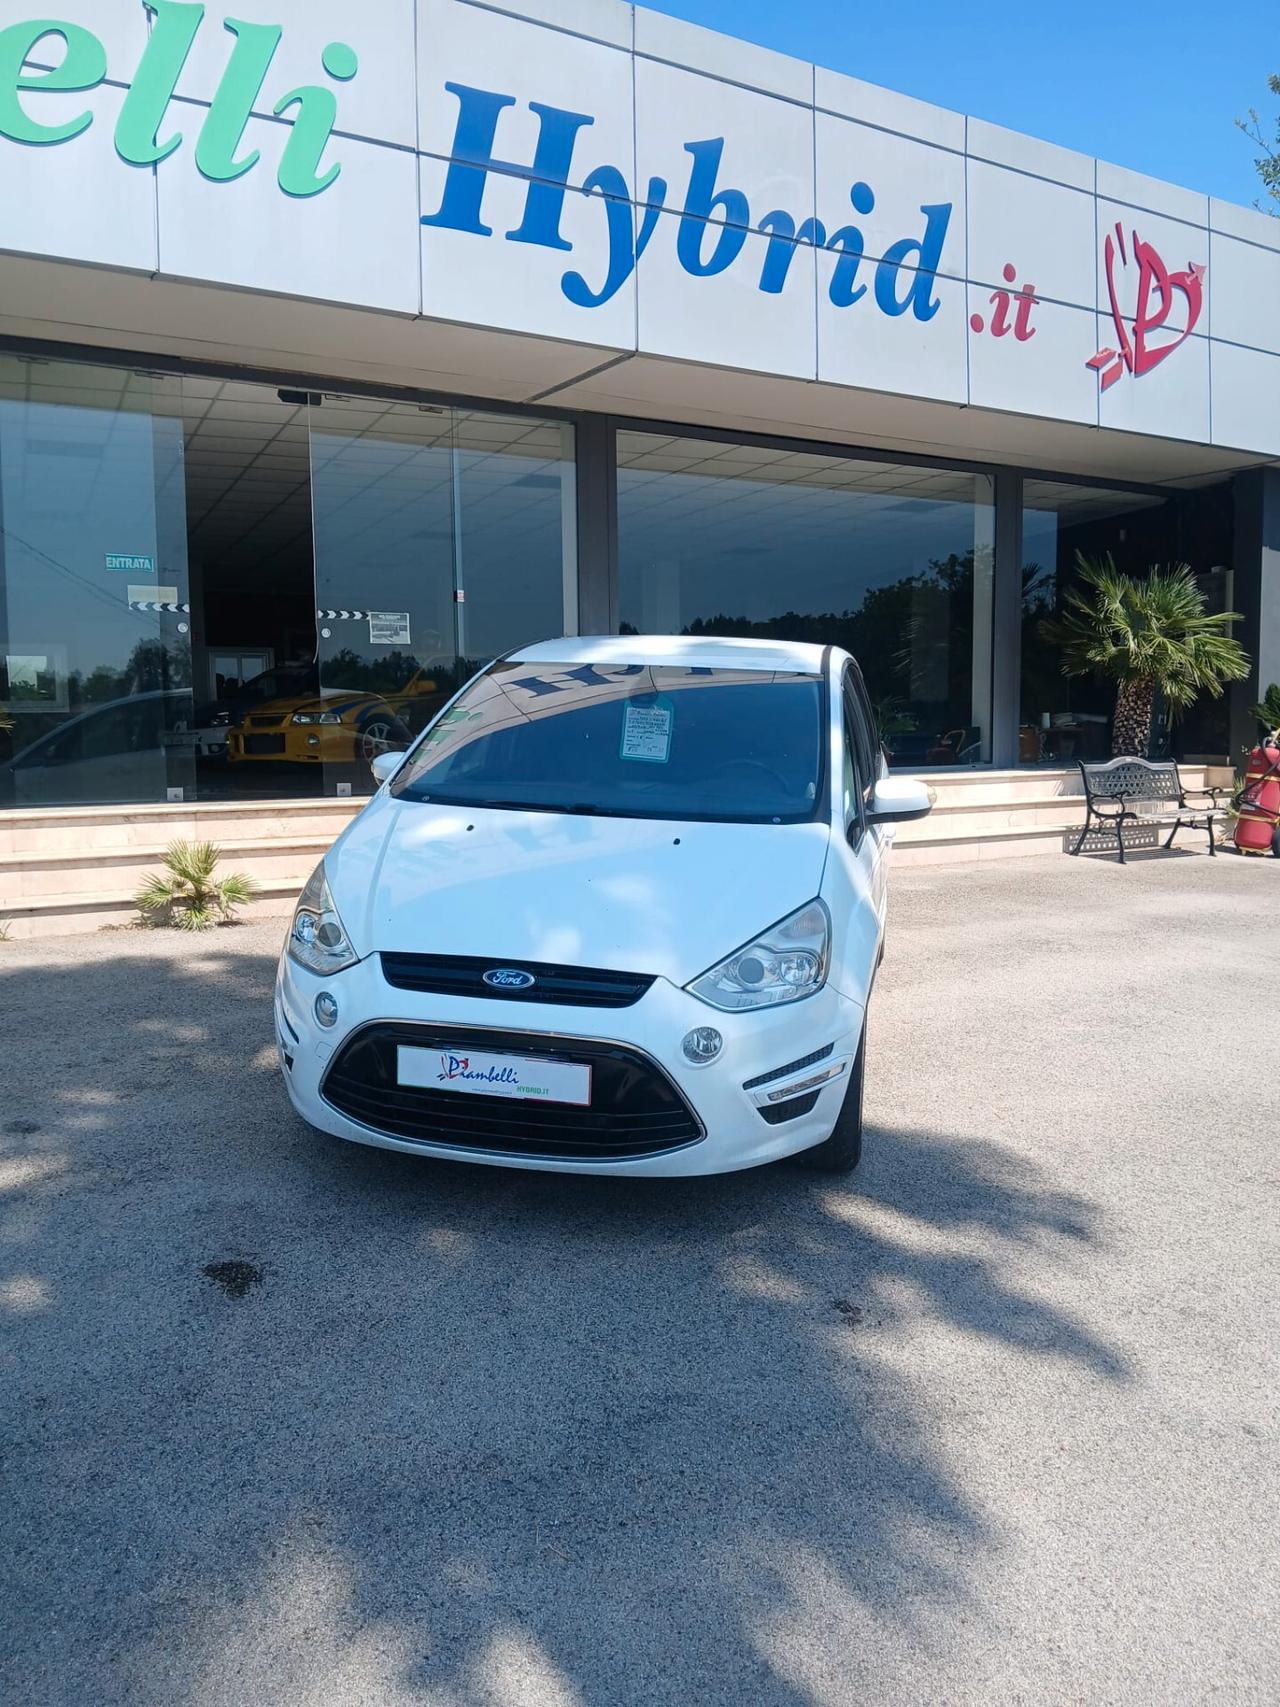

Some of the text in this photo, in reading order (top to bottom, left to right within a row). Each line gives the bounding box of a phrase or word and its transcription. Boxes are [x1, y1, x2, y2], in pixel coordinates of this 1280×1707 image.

[0, 0, 1041, 342] elli Hybrid .it
[105, 556, 152, 570] ENTRATA
[491, 969, 523, 985] Ford
[516, 1085, 550, 1096] HYBRID.IT
